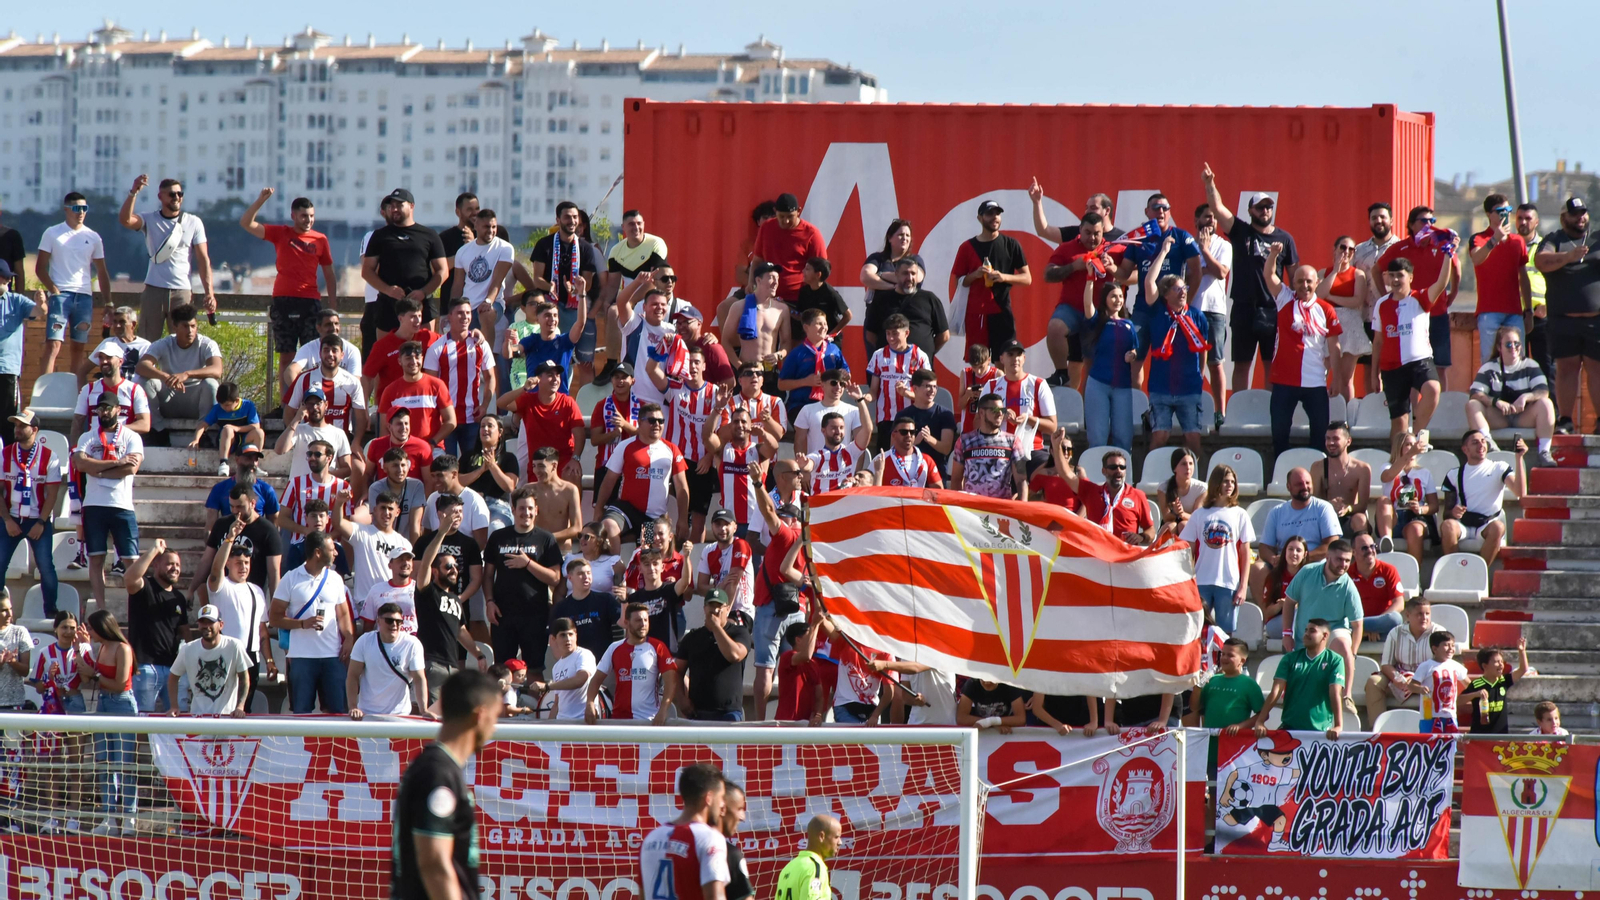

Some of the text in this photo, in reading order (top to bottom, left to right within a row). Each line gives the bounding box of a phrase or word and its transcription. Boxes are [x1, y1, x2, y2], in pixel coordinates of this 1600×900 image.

[971, 448, 1006, 457] HUGOBOSS
[1251, 773, 1277, 786] 1909
[1295, 739, 1454, 803] YOUTH BOYS
[1290, 791, 1444, 855] GRADA ACF
[488, 828, 588, 847] GRADA
